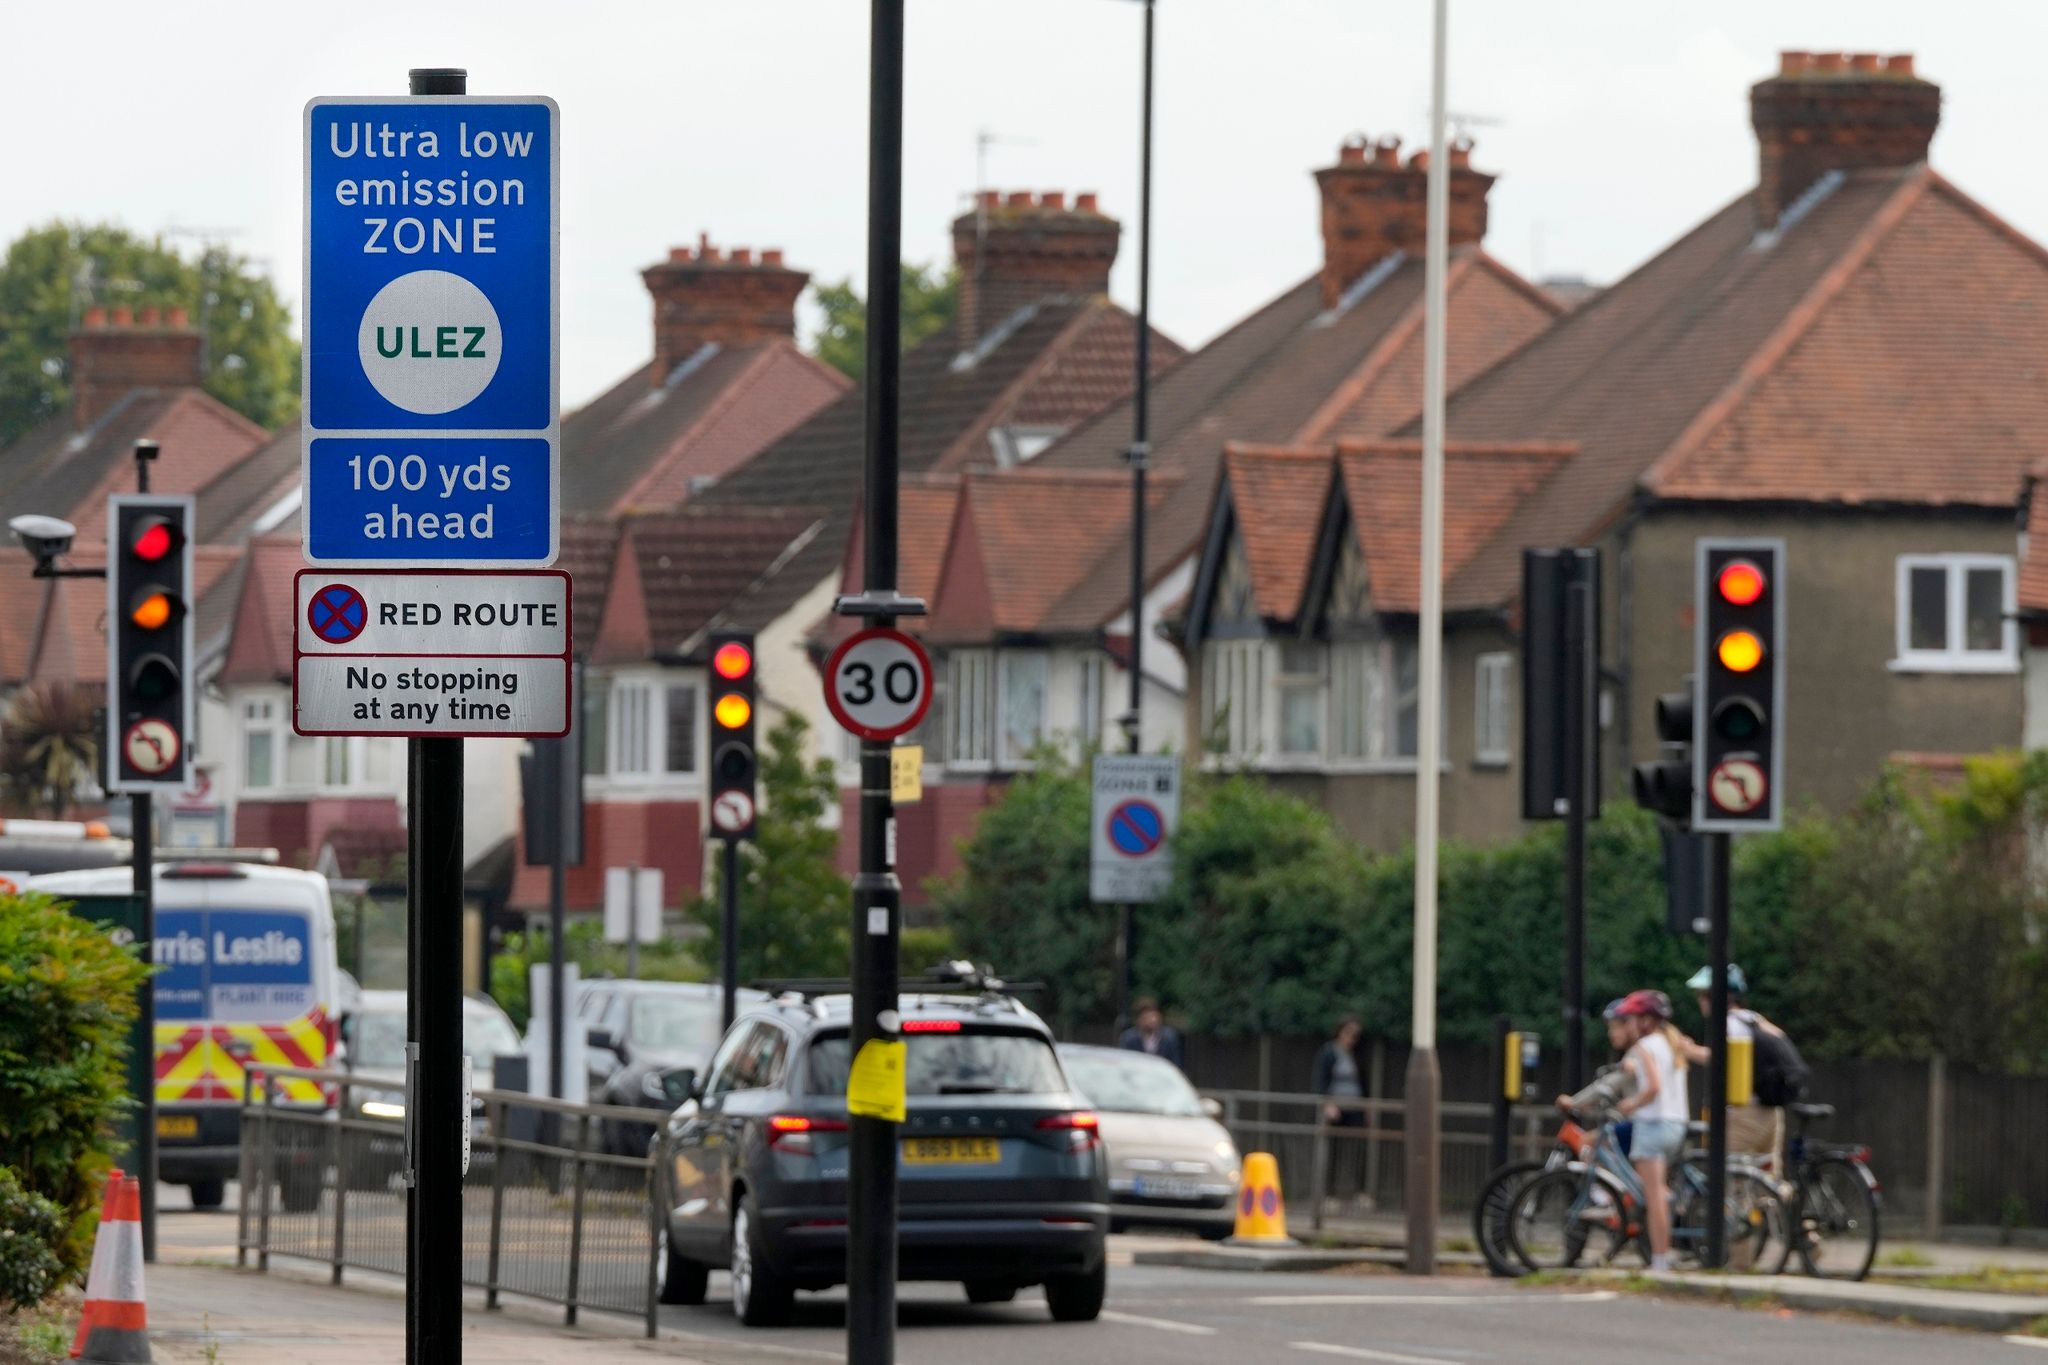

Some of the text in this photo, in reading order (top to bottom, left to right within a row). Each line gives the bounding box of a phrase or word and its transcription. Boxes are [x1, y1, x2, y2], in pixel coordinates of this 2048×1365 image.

[330, 122, 534, 158] Ultra low
[335, 170, 524, 206] emission
[363, 217, 497, 255] ZONE
[376, 326, 486, 359] ULEZ
[348, 454, 511, 498] 100 yds
[363, 503, 494, 539] ahead
[379, 602, 558, 627] RED ROUTE
[346, 666, 518, 694] No stopping
[842, 660, 919, 706] 30
[353, 696, 511, 724] at any time
[153, 930, 303, 966] rris Leslie
